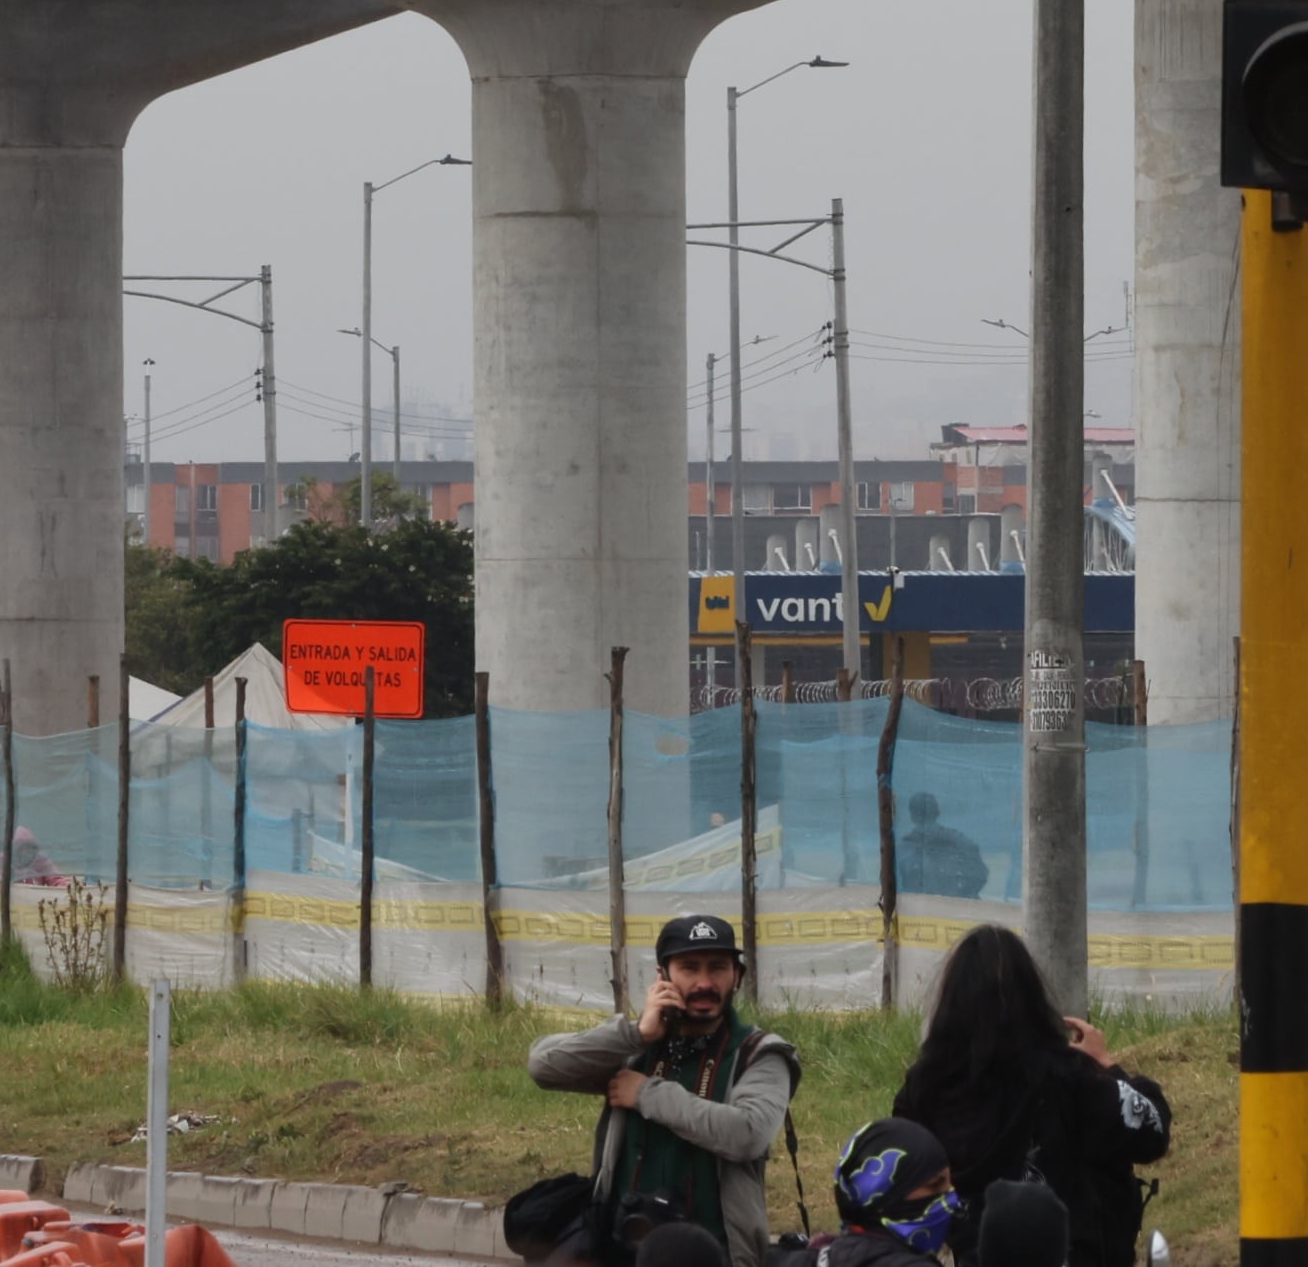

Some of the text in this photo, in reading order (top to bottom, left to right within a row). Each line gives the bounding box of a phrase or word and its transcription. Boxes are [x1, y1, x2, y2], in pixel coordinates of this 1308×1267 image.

[756, 592, 845, 622] vant
[290, 644, 416, 662] ENTRADA Y SALIDA
[304, 670, 401, 687] DE VOLQUTAS
